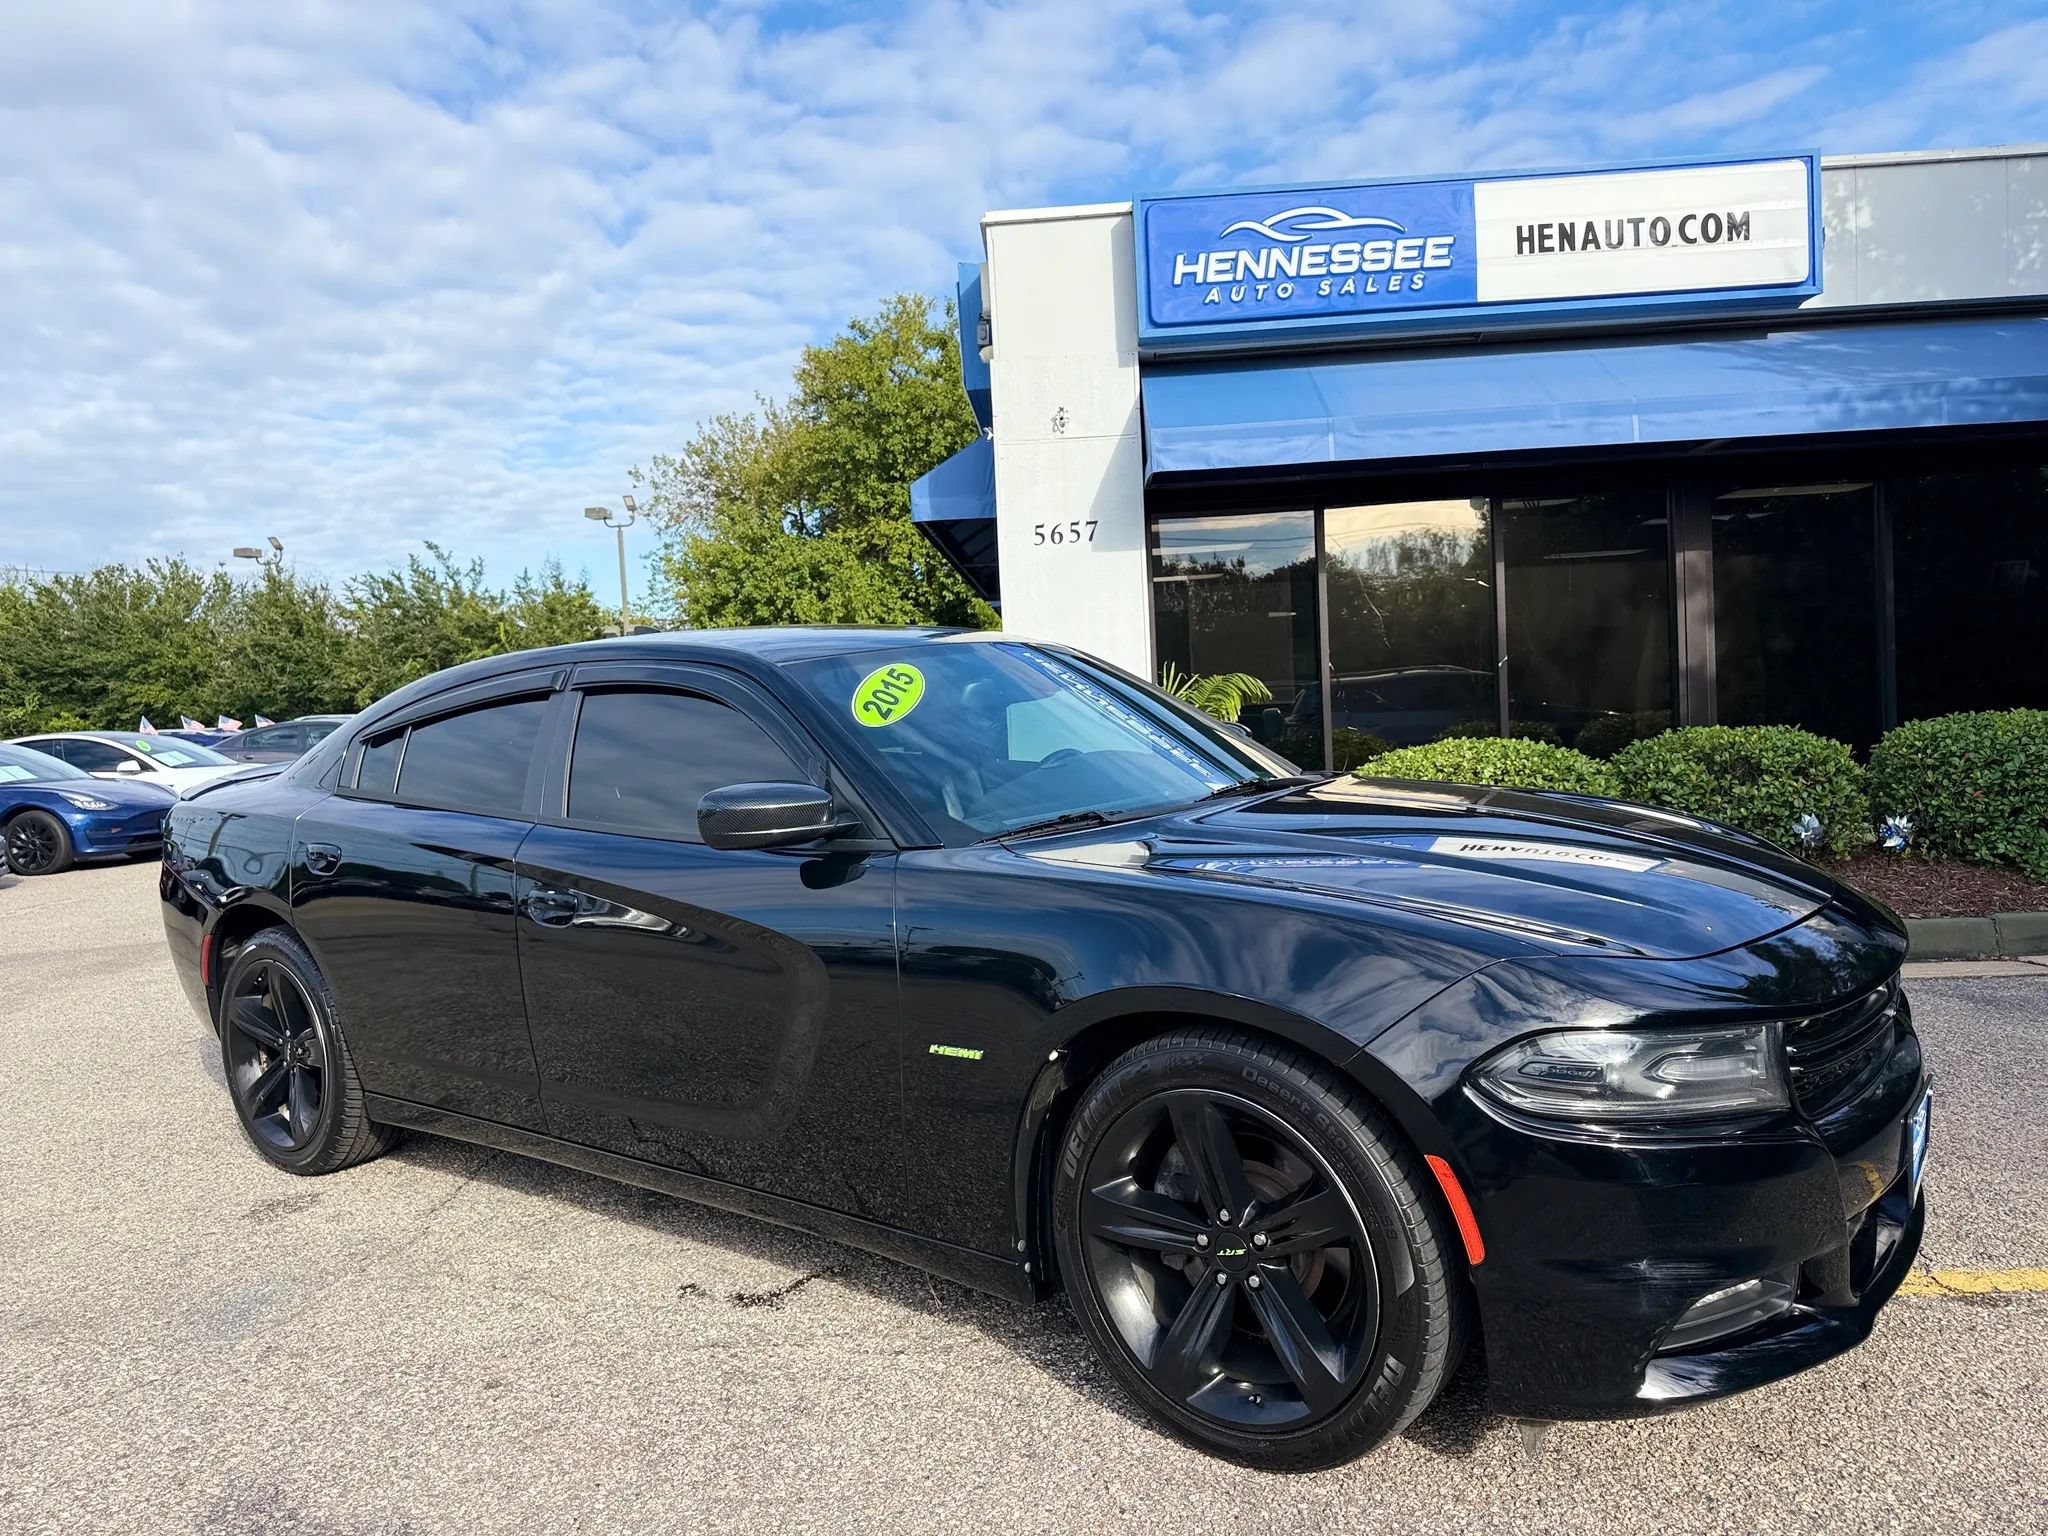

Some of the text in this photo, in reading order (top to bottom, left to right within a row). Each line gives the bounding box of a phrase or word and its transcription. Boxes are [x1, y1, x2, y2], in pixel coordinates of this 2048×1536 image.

[1173, 235, 1455, 285] HENNESSEE
[1204, 272, 1425, 304] AUTO SALES
[1034, 520, 1098, 546] 5657
[863, 668, 914, 720] 2015
[929, 1044, 983, 1060] HEMI
[1242, 1064, 1312, 1113] Desert
[1216, 1248, 1247, 1256] SRT
